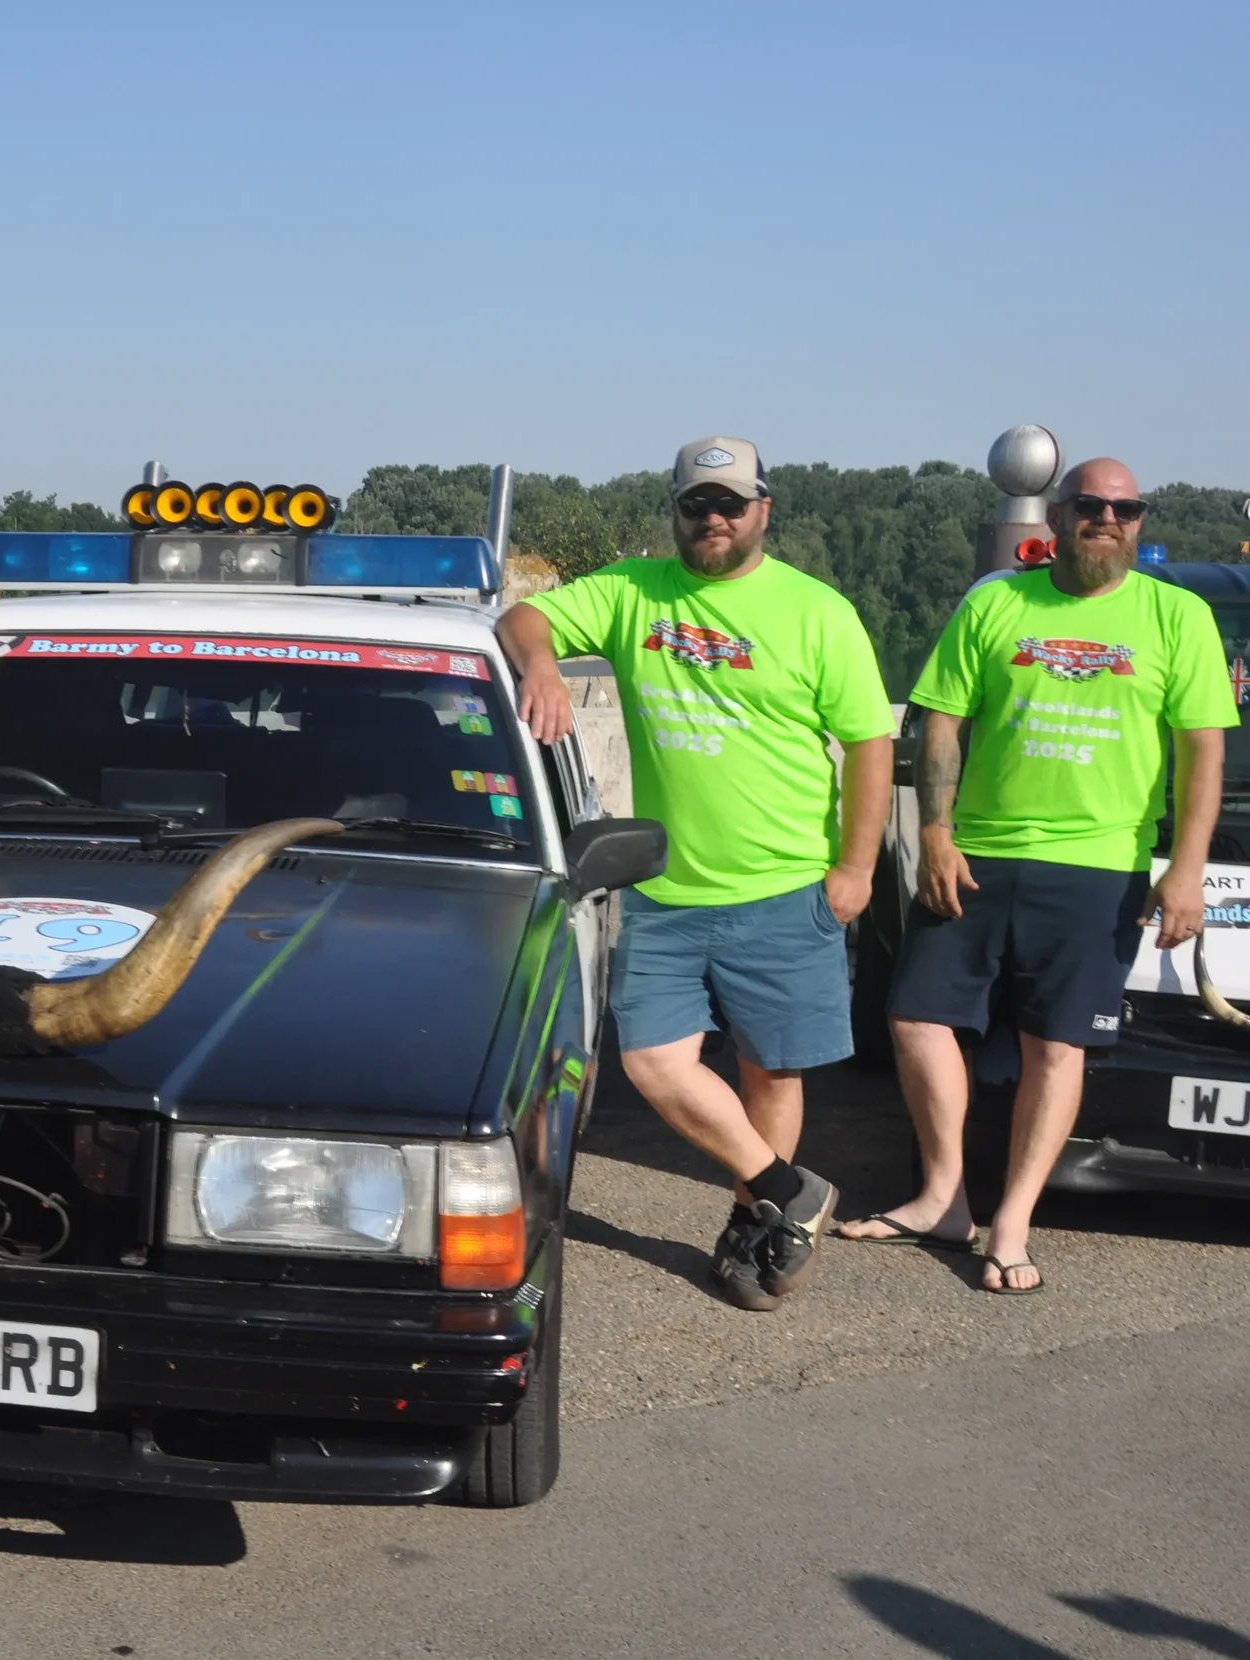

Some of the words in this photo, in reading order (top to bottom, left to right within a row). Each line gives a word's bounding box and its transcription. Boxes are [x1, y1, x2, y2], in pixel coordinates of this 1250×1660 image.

[28, 639, 141, 656] Barmy
[148, 641, 184, 654] to
[191, 641, 362, 663] Barcelona
[1031, 648, 1076, 667] Wacky
[1080, 655, 1117, 666] Rally
[654, 728, 725, 757] 2025
[1021, 739, 1095, 765] 2025
